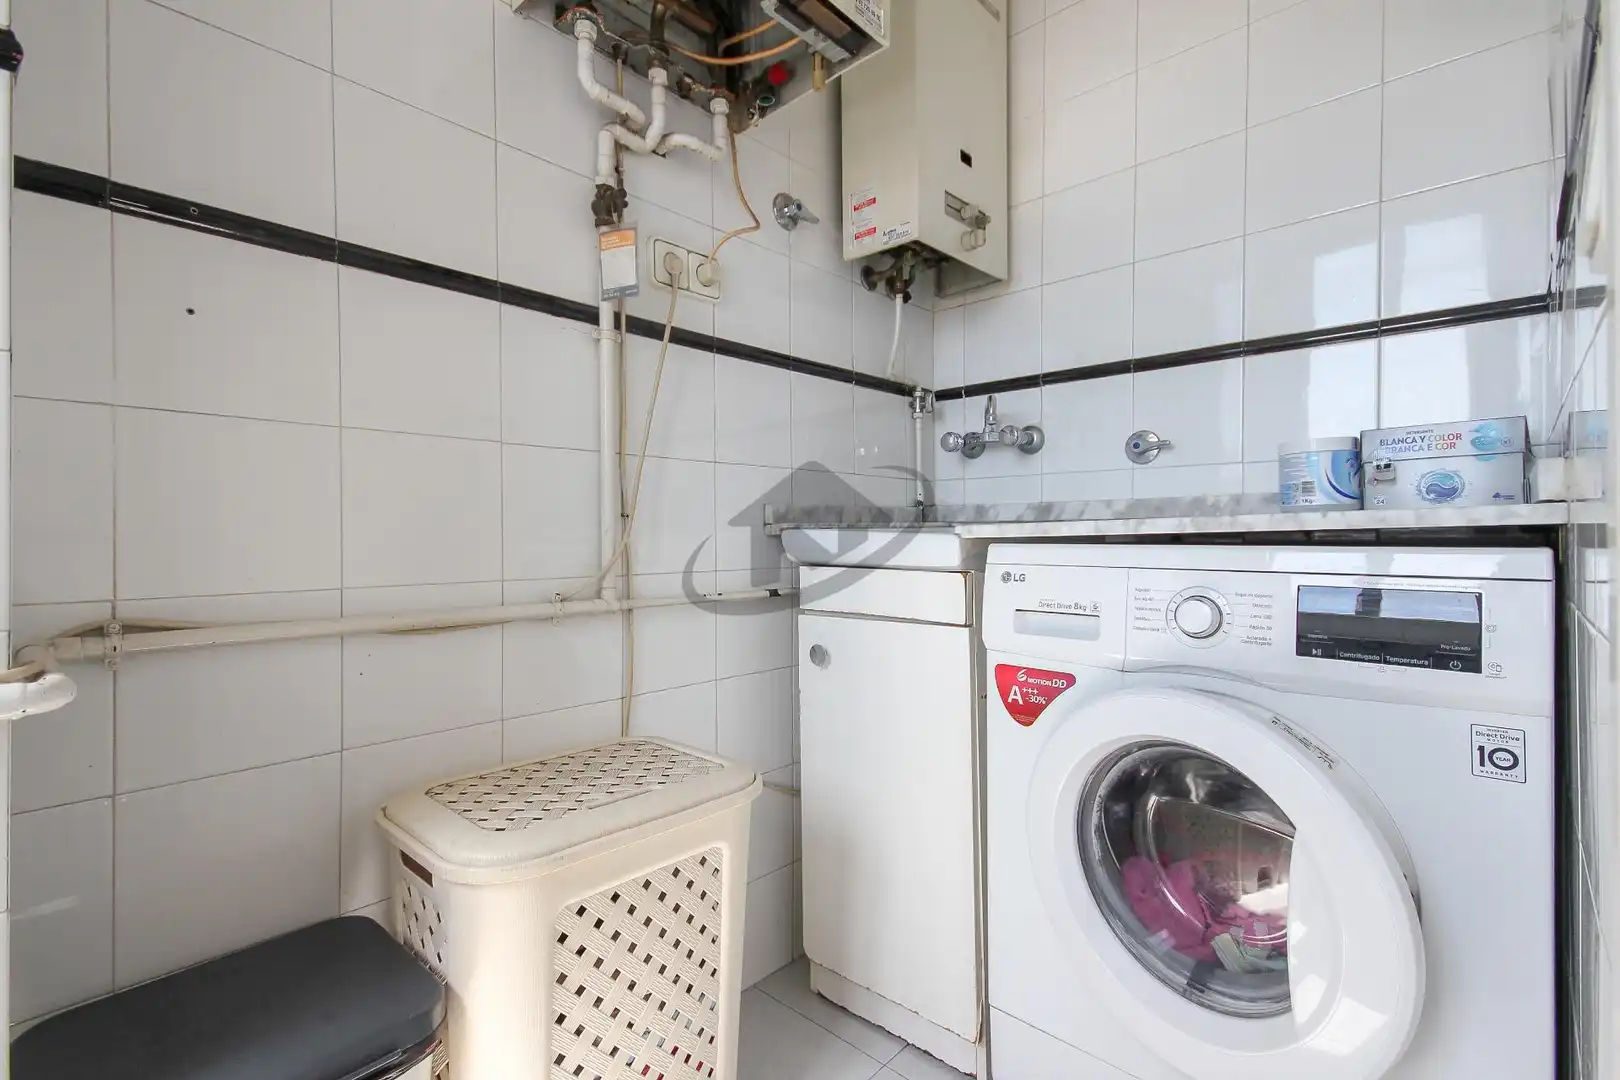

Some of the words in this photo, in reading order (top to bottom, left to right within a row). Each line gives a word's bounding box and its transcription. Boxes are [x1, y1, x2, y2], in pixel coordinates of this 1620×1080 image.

[1380, 436, 1418, 447] BLANCA
[1428, 433, 1462, 442] COLOR
[1385, 444, 1425, 454] BRANCA
[1427, 443, 1433, 451] E
[1435, 442, 1457, 451] COR
[1013, 573, 1026, 582] LG
[1038, 601, 1056, 609] Direct
[1057, 602, 1072, 610] Drive
[1339, 651, 1380, 661] Centrifugado
[1385, 655, 1429, 666] Temperatura
[1028, 677, 1052, 687] MOTION
[1052, 679, 1067, 688] DD
[1477, 745, 1519, 771] 10
[1480, 769, 1518, 778] WARRANTY
